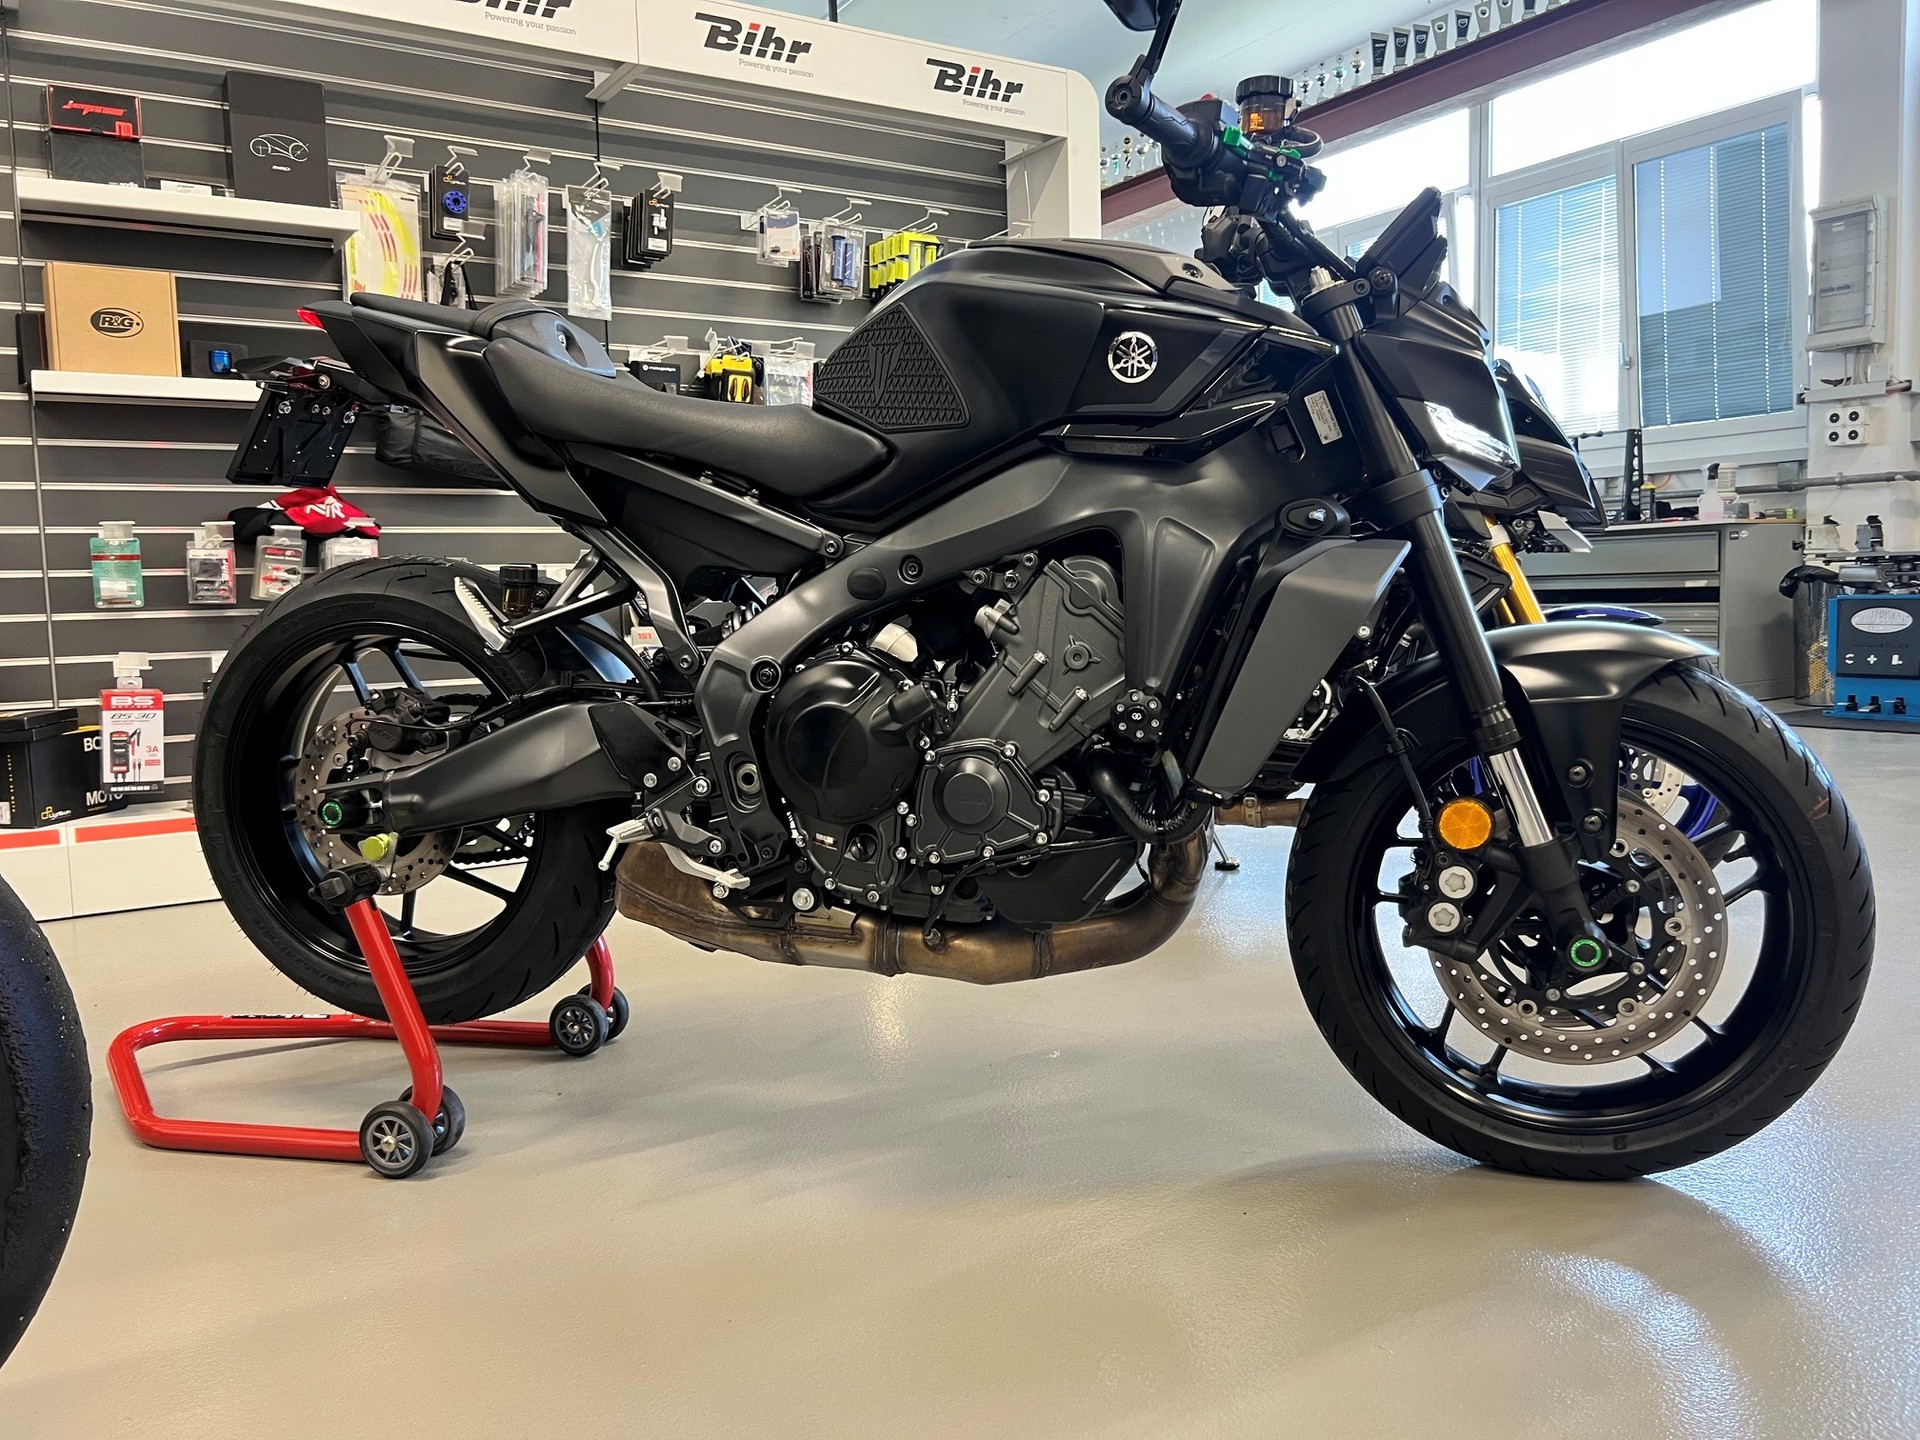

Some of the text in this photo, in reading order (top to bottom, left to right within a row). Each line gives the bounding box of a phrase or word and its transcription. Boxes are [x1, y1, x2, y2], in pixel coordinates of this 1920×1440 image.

[484, 11, 577, 36] Powering your passion
[695, 12, 812, 64] Bihr
[739, 58, 815, 78] Powering your passion
[926, 58, 1024, 103] Bihr
[962, 98, 990, 111] Powering
[990, 105, 1003, 113] your
[101, 315, 134, 329] R&G
[110, 695, 156, 706] BS
[83, 736, 103, 752] BO
[146, 745, 160, 754] 3A
